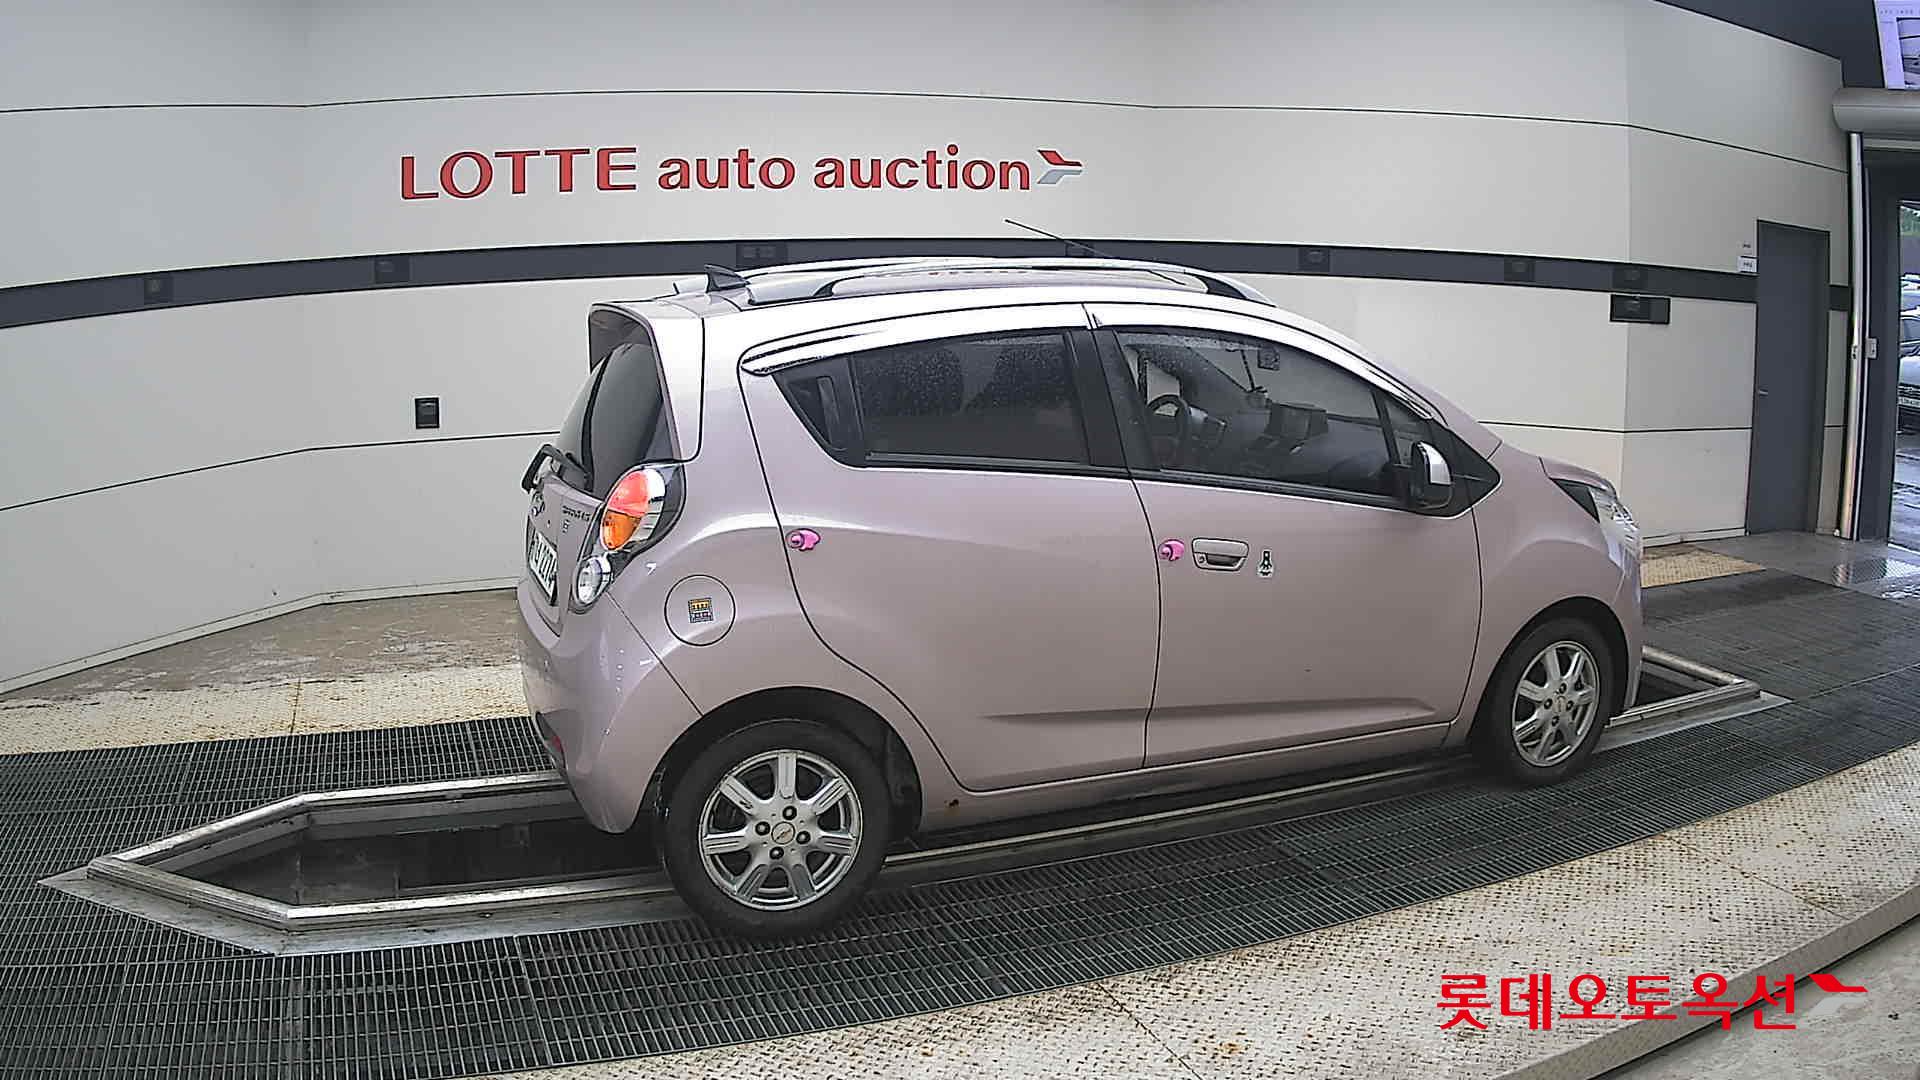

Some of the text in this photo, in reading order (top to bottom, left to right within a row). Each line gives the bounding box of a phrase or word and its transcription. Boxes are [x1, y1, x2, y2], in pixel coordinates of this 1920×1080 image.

[401, 144, 1030, 200] LOTTE auto auction
